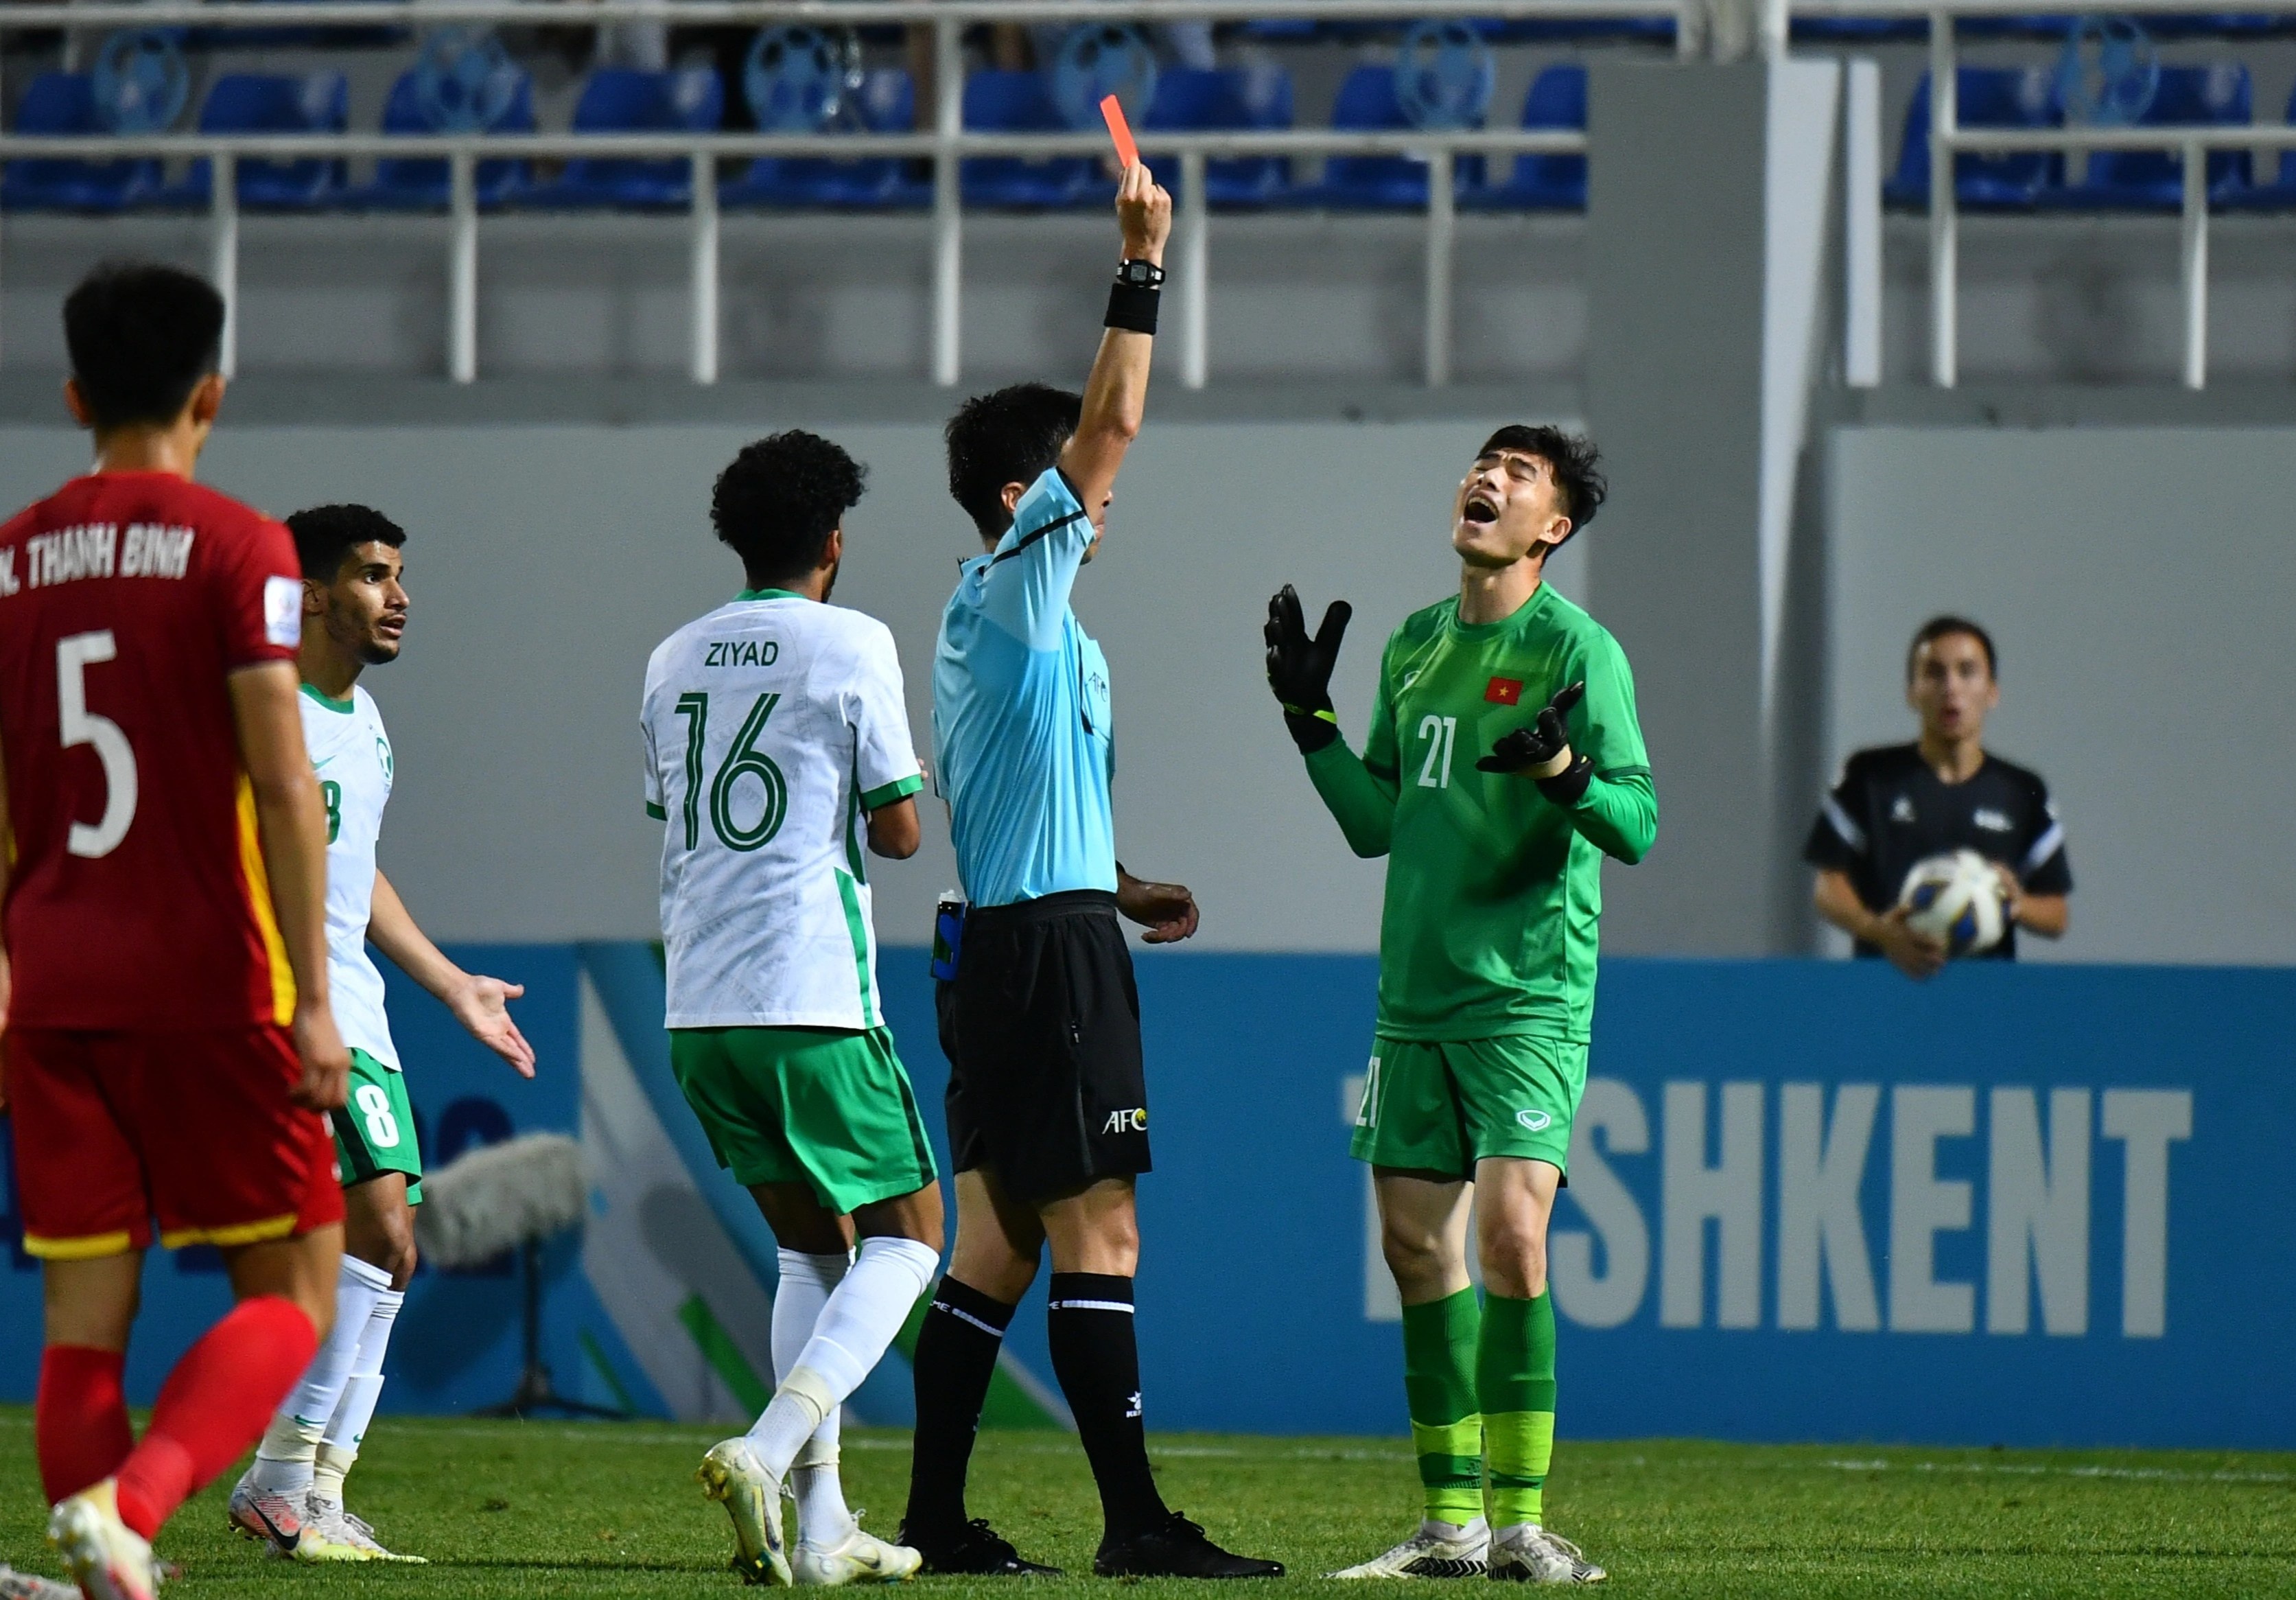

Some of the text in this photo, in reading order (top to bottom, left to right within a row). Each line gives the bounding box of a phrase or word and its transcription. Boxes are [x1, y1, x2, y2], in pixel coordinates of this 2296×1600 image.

[26, 522, 117, 589] THANH
[119, 522, 195, 579] BINH
[705, 640, 779, 667] ZIYAD
[57, 629, 137, 859] 5
[675, 693, 788, 852] 16
[1418, 715, 1457, 789] 21
[355, 1085, 400, 1148] 8
[1101, 1108, 1147, 1135] AFC
[1342, 1074, 2193, 1338] SHKENT
